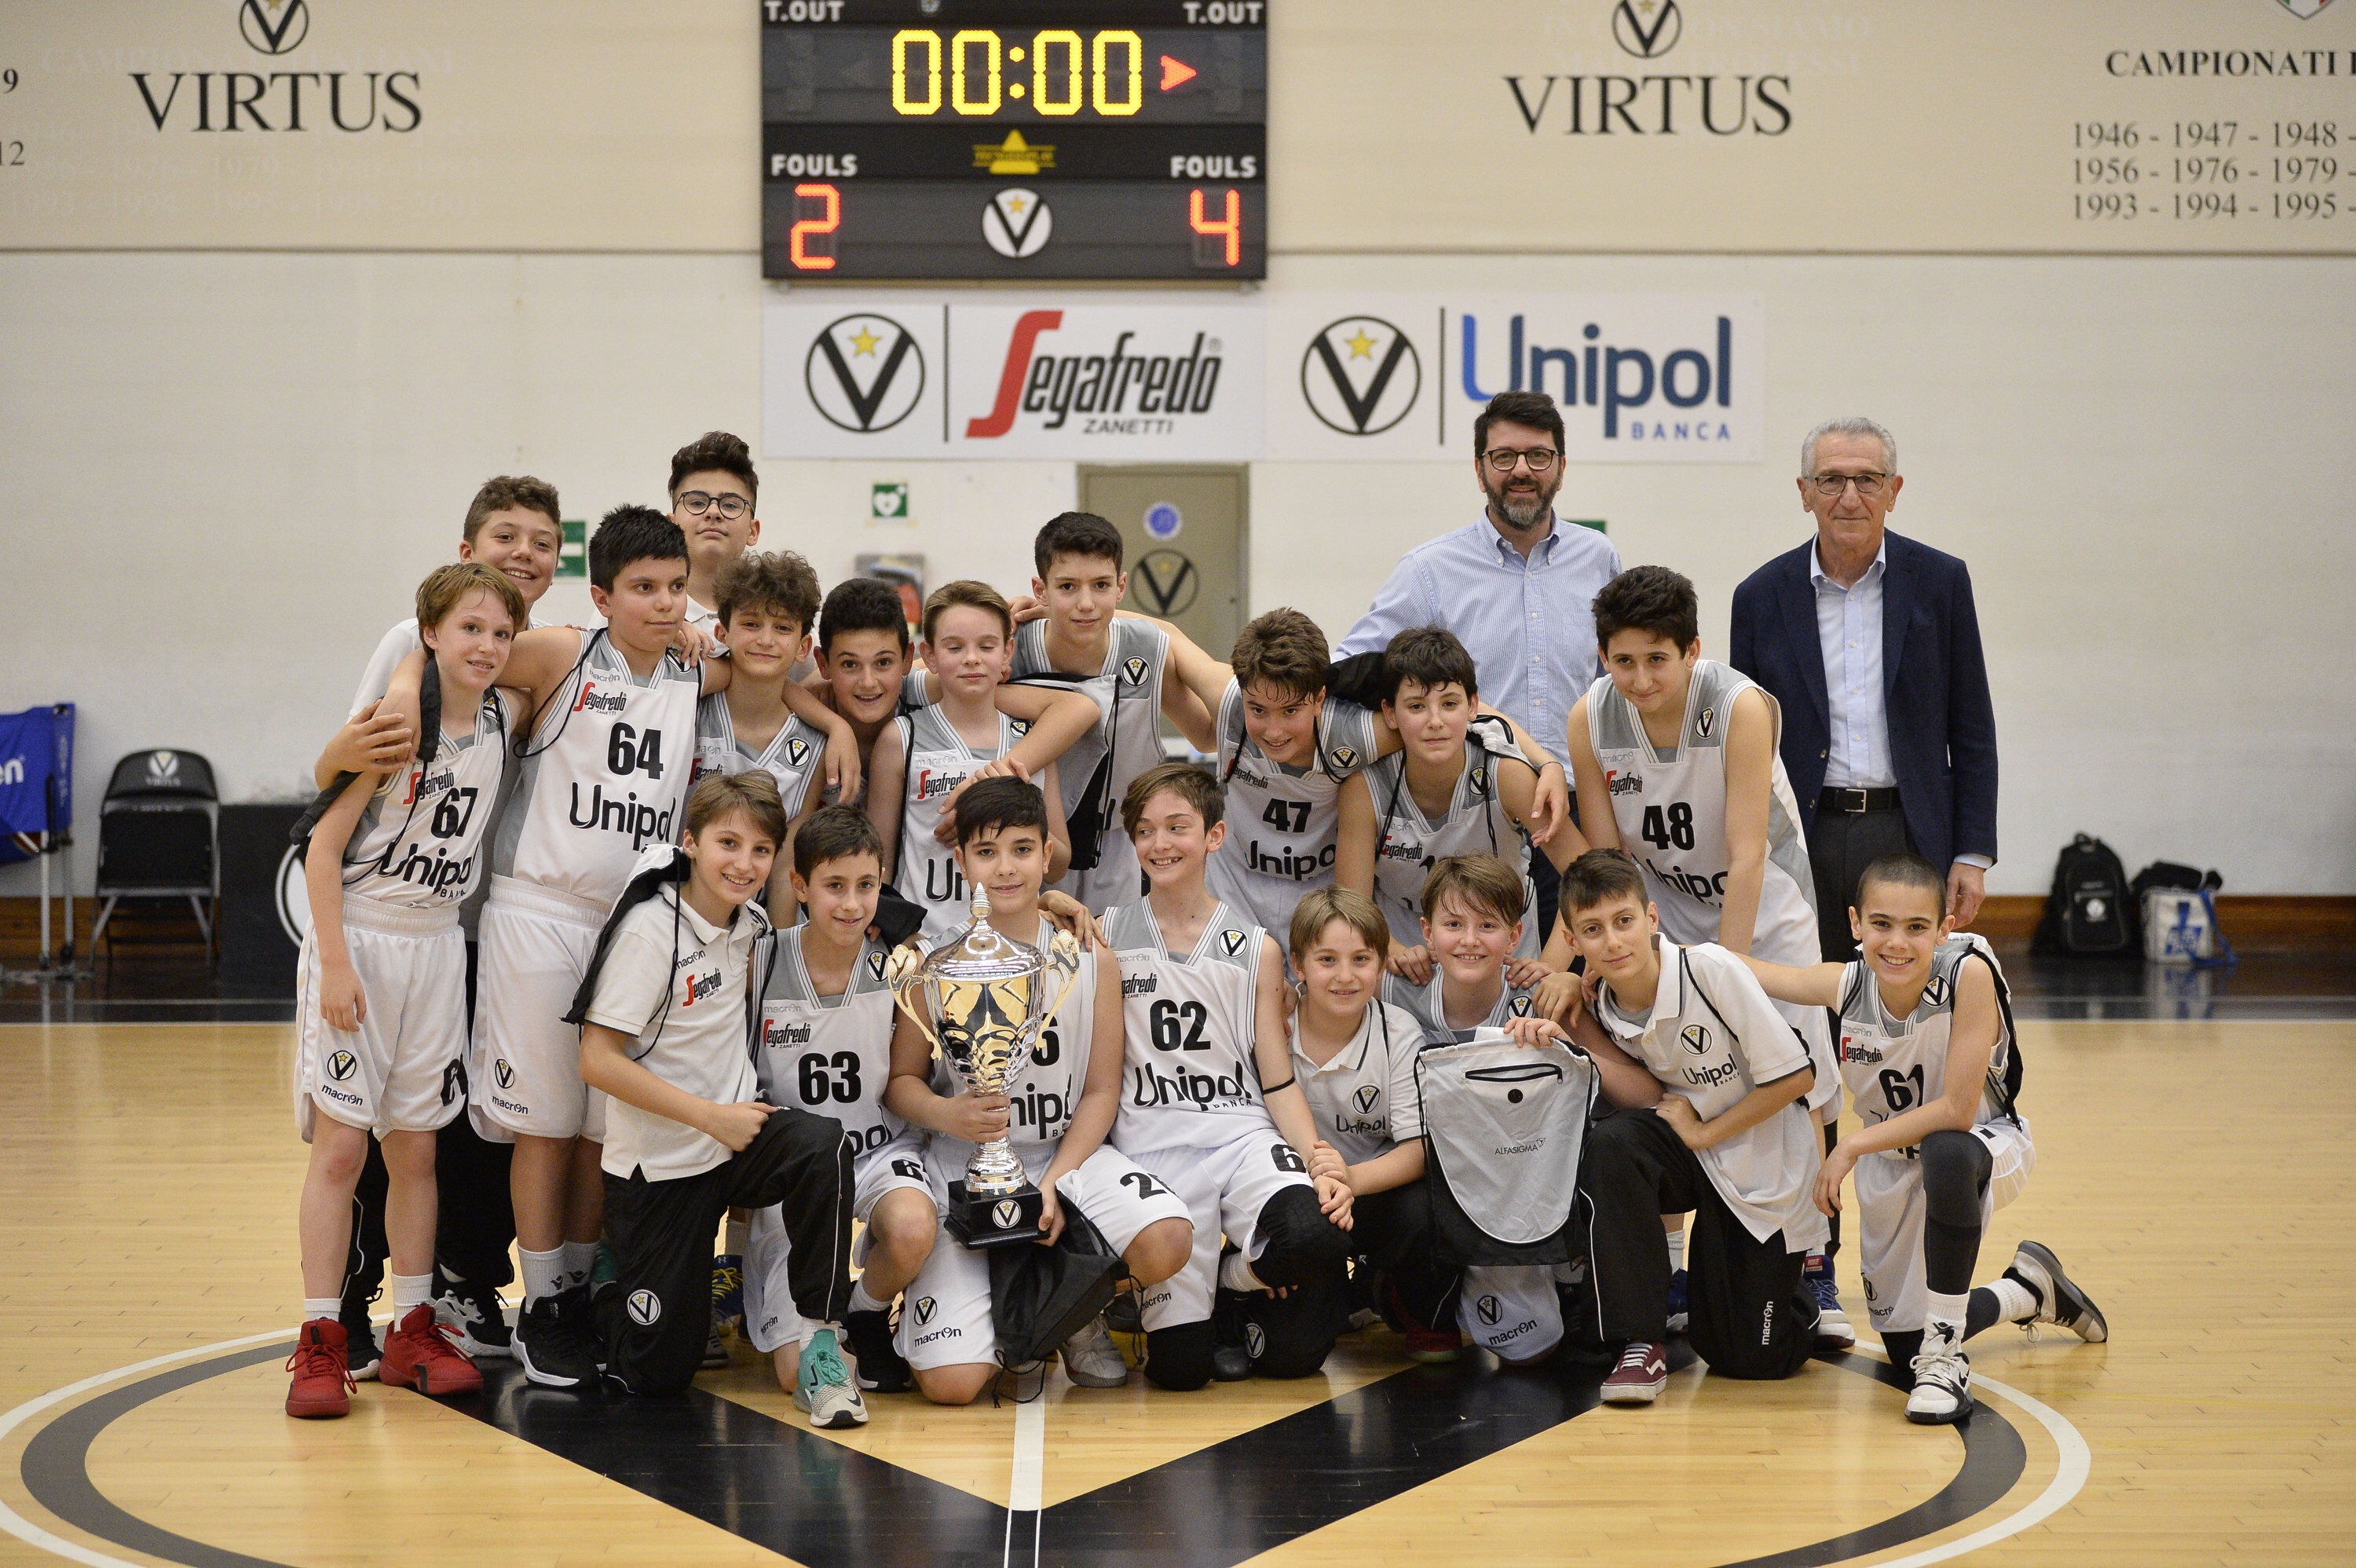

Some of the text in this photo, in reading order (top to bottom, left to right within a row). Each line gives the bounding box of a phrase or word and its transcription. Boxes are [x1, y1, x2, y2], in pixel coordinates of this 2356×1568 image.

[764, 0, 845, 22] T.OUT
[1182, 2, 1264, 24] T.OUT
[892, 30, 1142, 115] 00:00
[2105, 49, 2336, 78] CAMPIONATI
[127, 71, 423, 133] VIRTUS
[1502, 75, 1792, 137] VIRTUS
[2074, 121, 2140, 149] 1946
[2173, 121, 2239, 149] 1947
[2273, 121, 2338, 148] 1948
[771, 155, 858, 177] FOULS
[1170, 156, 1257, 179] FOULS
[2074, 157, 2140, 185] 1956
[2173, 157, 2239, 185] 1976
[2273, 157, 2338, 185] 1979
[2074, 192, 2140, 221] 1993
[2173, 192, 2239, 221] 1994
[2273, 192, 2338, 220] 1995
[789, 184, 840, 269] 2
[1189, 189, 1240, 265] 4
[964, 309, 1223, 439] Segafredo
[1462, 313, 1733, 439] Unipol
[1084, 418, 1174, 435] ZANETTI
[1632, 422, 1730, 440] BANCA
[573, 682, 627, 711] Segafredo
[607, 722, 664, 780] 64
[430, 787, 479, 839] 67
[569, 782, 676, 852] Unipol
[1262, 798, 1312, 833] 47
[1641, 802, 1696, 851] 48
[1244, 839, 1337, 881] Unipo
[682, 967, 722, 1007] Segafredo
[1150, 999, 1211, 1051] 62
[1840, 1036, 1883, 1064] Segafredo
[798, 1051, 861, 1106] 63
[1134, 1060, 1252, 1112] Unipol
[1682, 1053, 1738, 1087] Unipol
[321, 1084, 363, 1106] macron
[492, 1095, 529, 1115] macron
[1879, 1064, 1924, 1112] 61
[1335, 1113, 1386, 1135] Unipol
[1494, 1144, 1538, 1155] ALFASIGMA
[915, 1326, 962, 1348] macron
[1488, 1319, 1538, 1346] macron
[1762, 1300, 1774, 1346] macron
